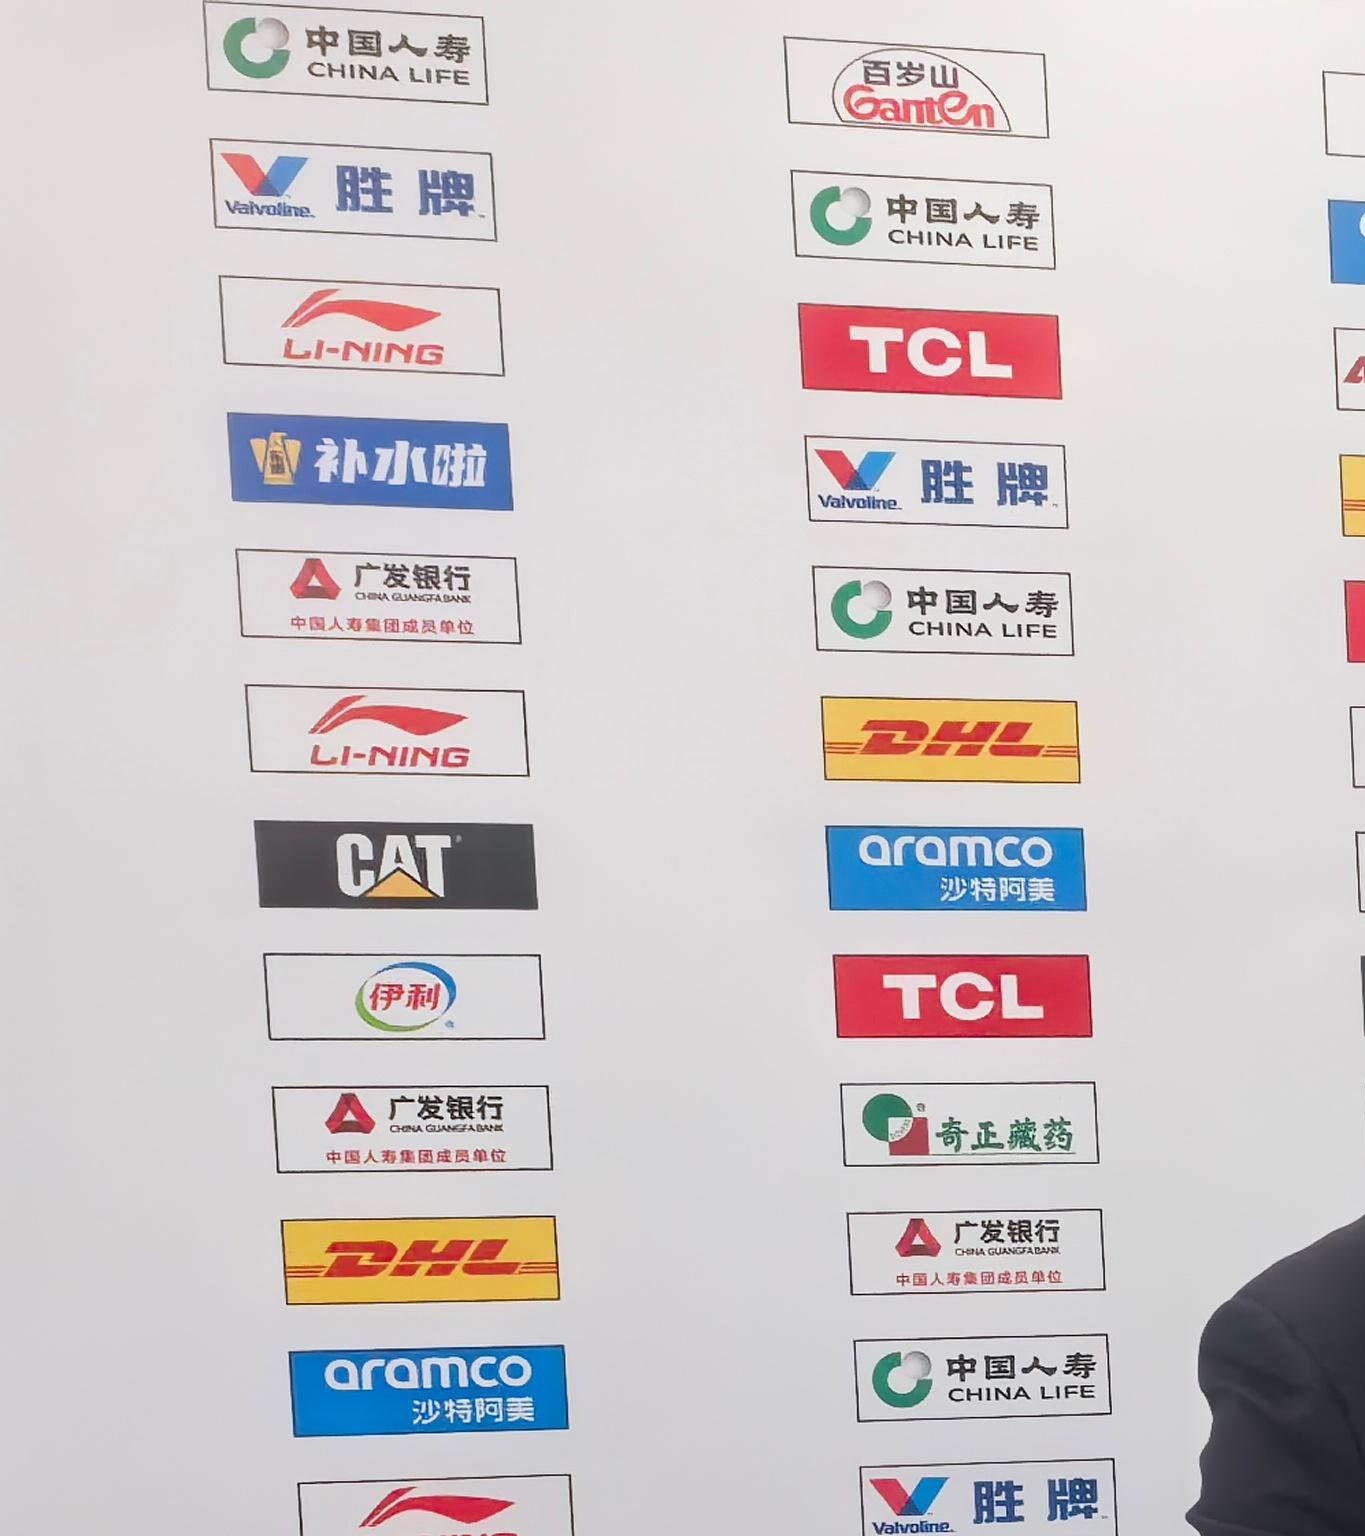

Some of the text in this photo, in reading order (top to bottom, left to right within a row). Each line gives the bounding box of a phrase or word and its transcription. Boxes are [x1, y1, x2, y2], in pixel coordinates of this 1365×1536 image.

[303, 24, 472, 65] 中国人寿
[307, 61, 471, 87] CHINA LIFE
[862, 59, 960, 91] 百岁山
[885, 193, 1041, 231] 中国人寿
[888, 228, 1039, 252] CHINA LIFE
[281, 338, 446, 365] LI-NING
[848, 322, 1014, 379] TCL
[312, 437, 489, 489] 补水啦
[353, 561, 471, 591] 广发银行
[905, 586, 1059, 619] 中国人寿
[908, 620, 1058, 639] CHINA LIFE
[858, 718, 1044, 757] DHL
[308, 744, 472, 767] LI-NING
[334, 833, 454, 897] CAT
[856, 834, 1053, 867] aramco
[937, 876, 1056, 902] 沙特阿美
[368, 982, 443, 1011] 伊利
[882, 971, 1045, 1019] TCL
[387, 1094, 504, 1121] 广发银行
[933, 1114, 1074, 1152] 奇正藏药
[952, 1218, 1060, 1245] 广发银行
[322, 1238, 521, 1278] DHL
[322, 1354, 533, 1391] aramco
[945, 1351, 1097, 1383] 中国人寿
[948, 1384, 1095, 1403] CHINA LIFE
[409, 1396, 536, 1425] 沙特阿美
